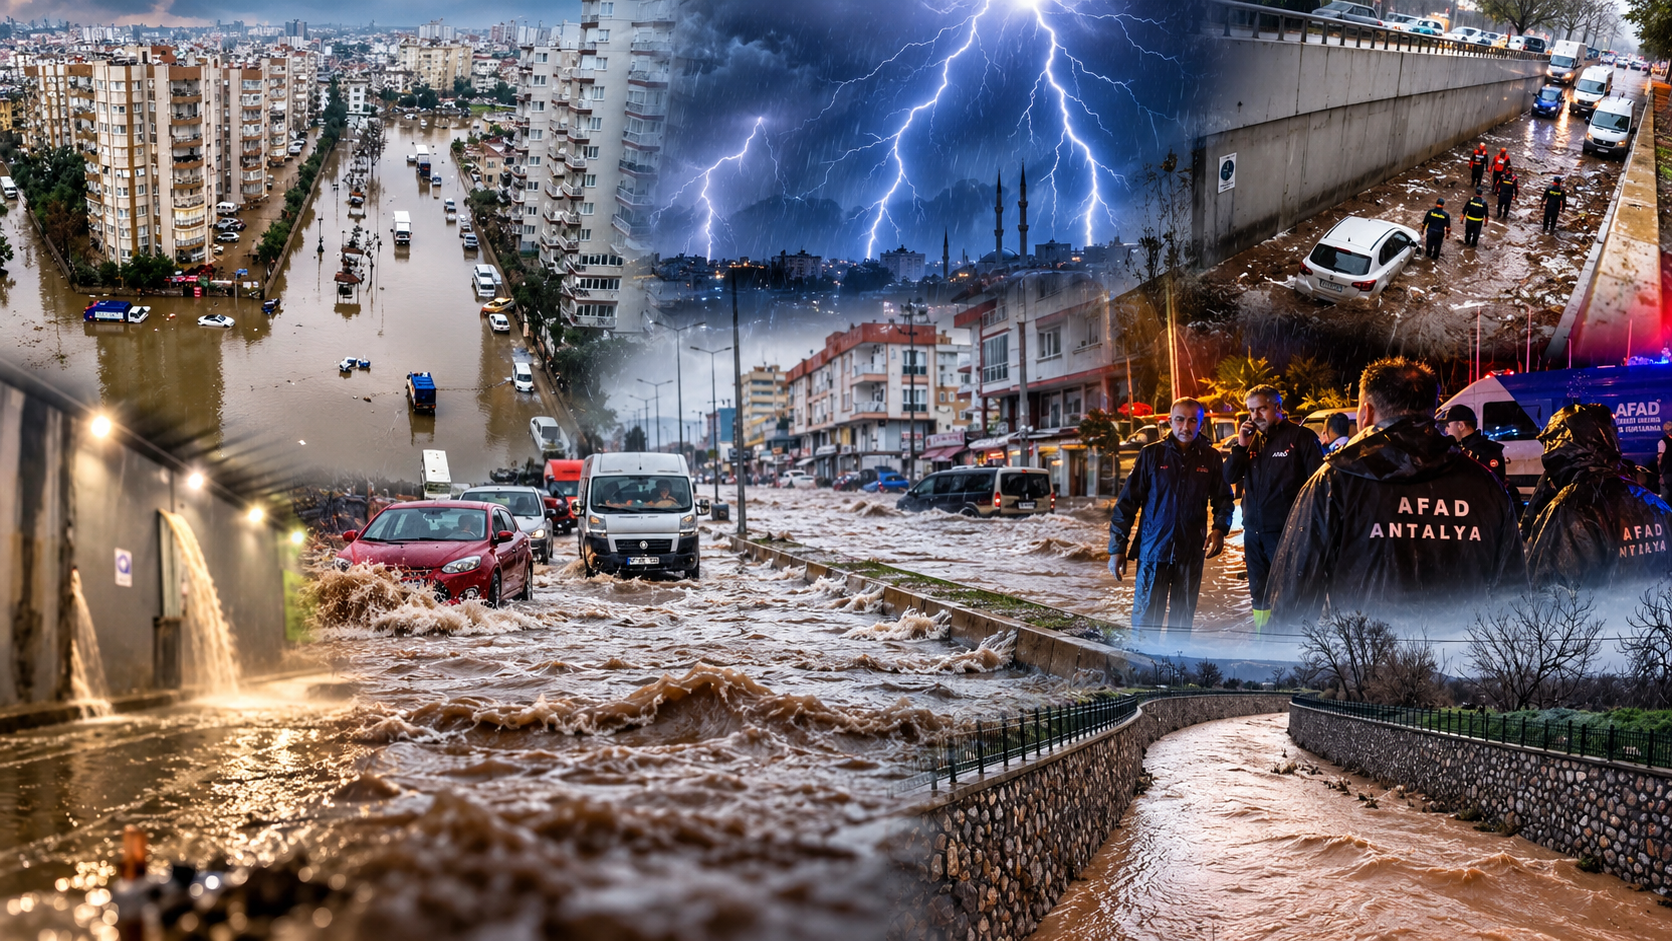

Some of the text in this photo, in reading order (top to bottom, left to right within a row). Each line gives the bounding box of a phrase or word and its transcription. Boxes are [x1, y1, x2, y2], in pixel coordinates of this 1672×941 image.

[1616, 401, 1660, 417] AFAD
[1397, 496, 1470, 517] AFAD
[1369, 522, 1482, 541] ANTALYA
[1623, 523, 1663, 541] AFAD
